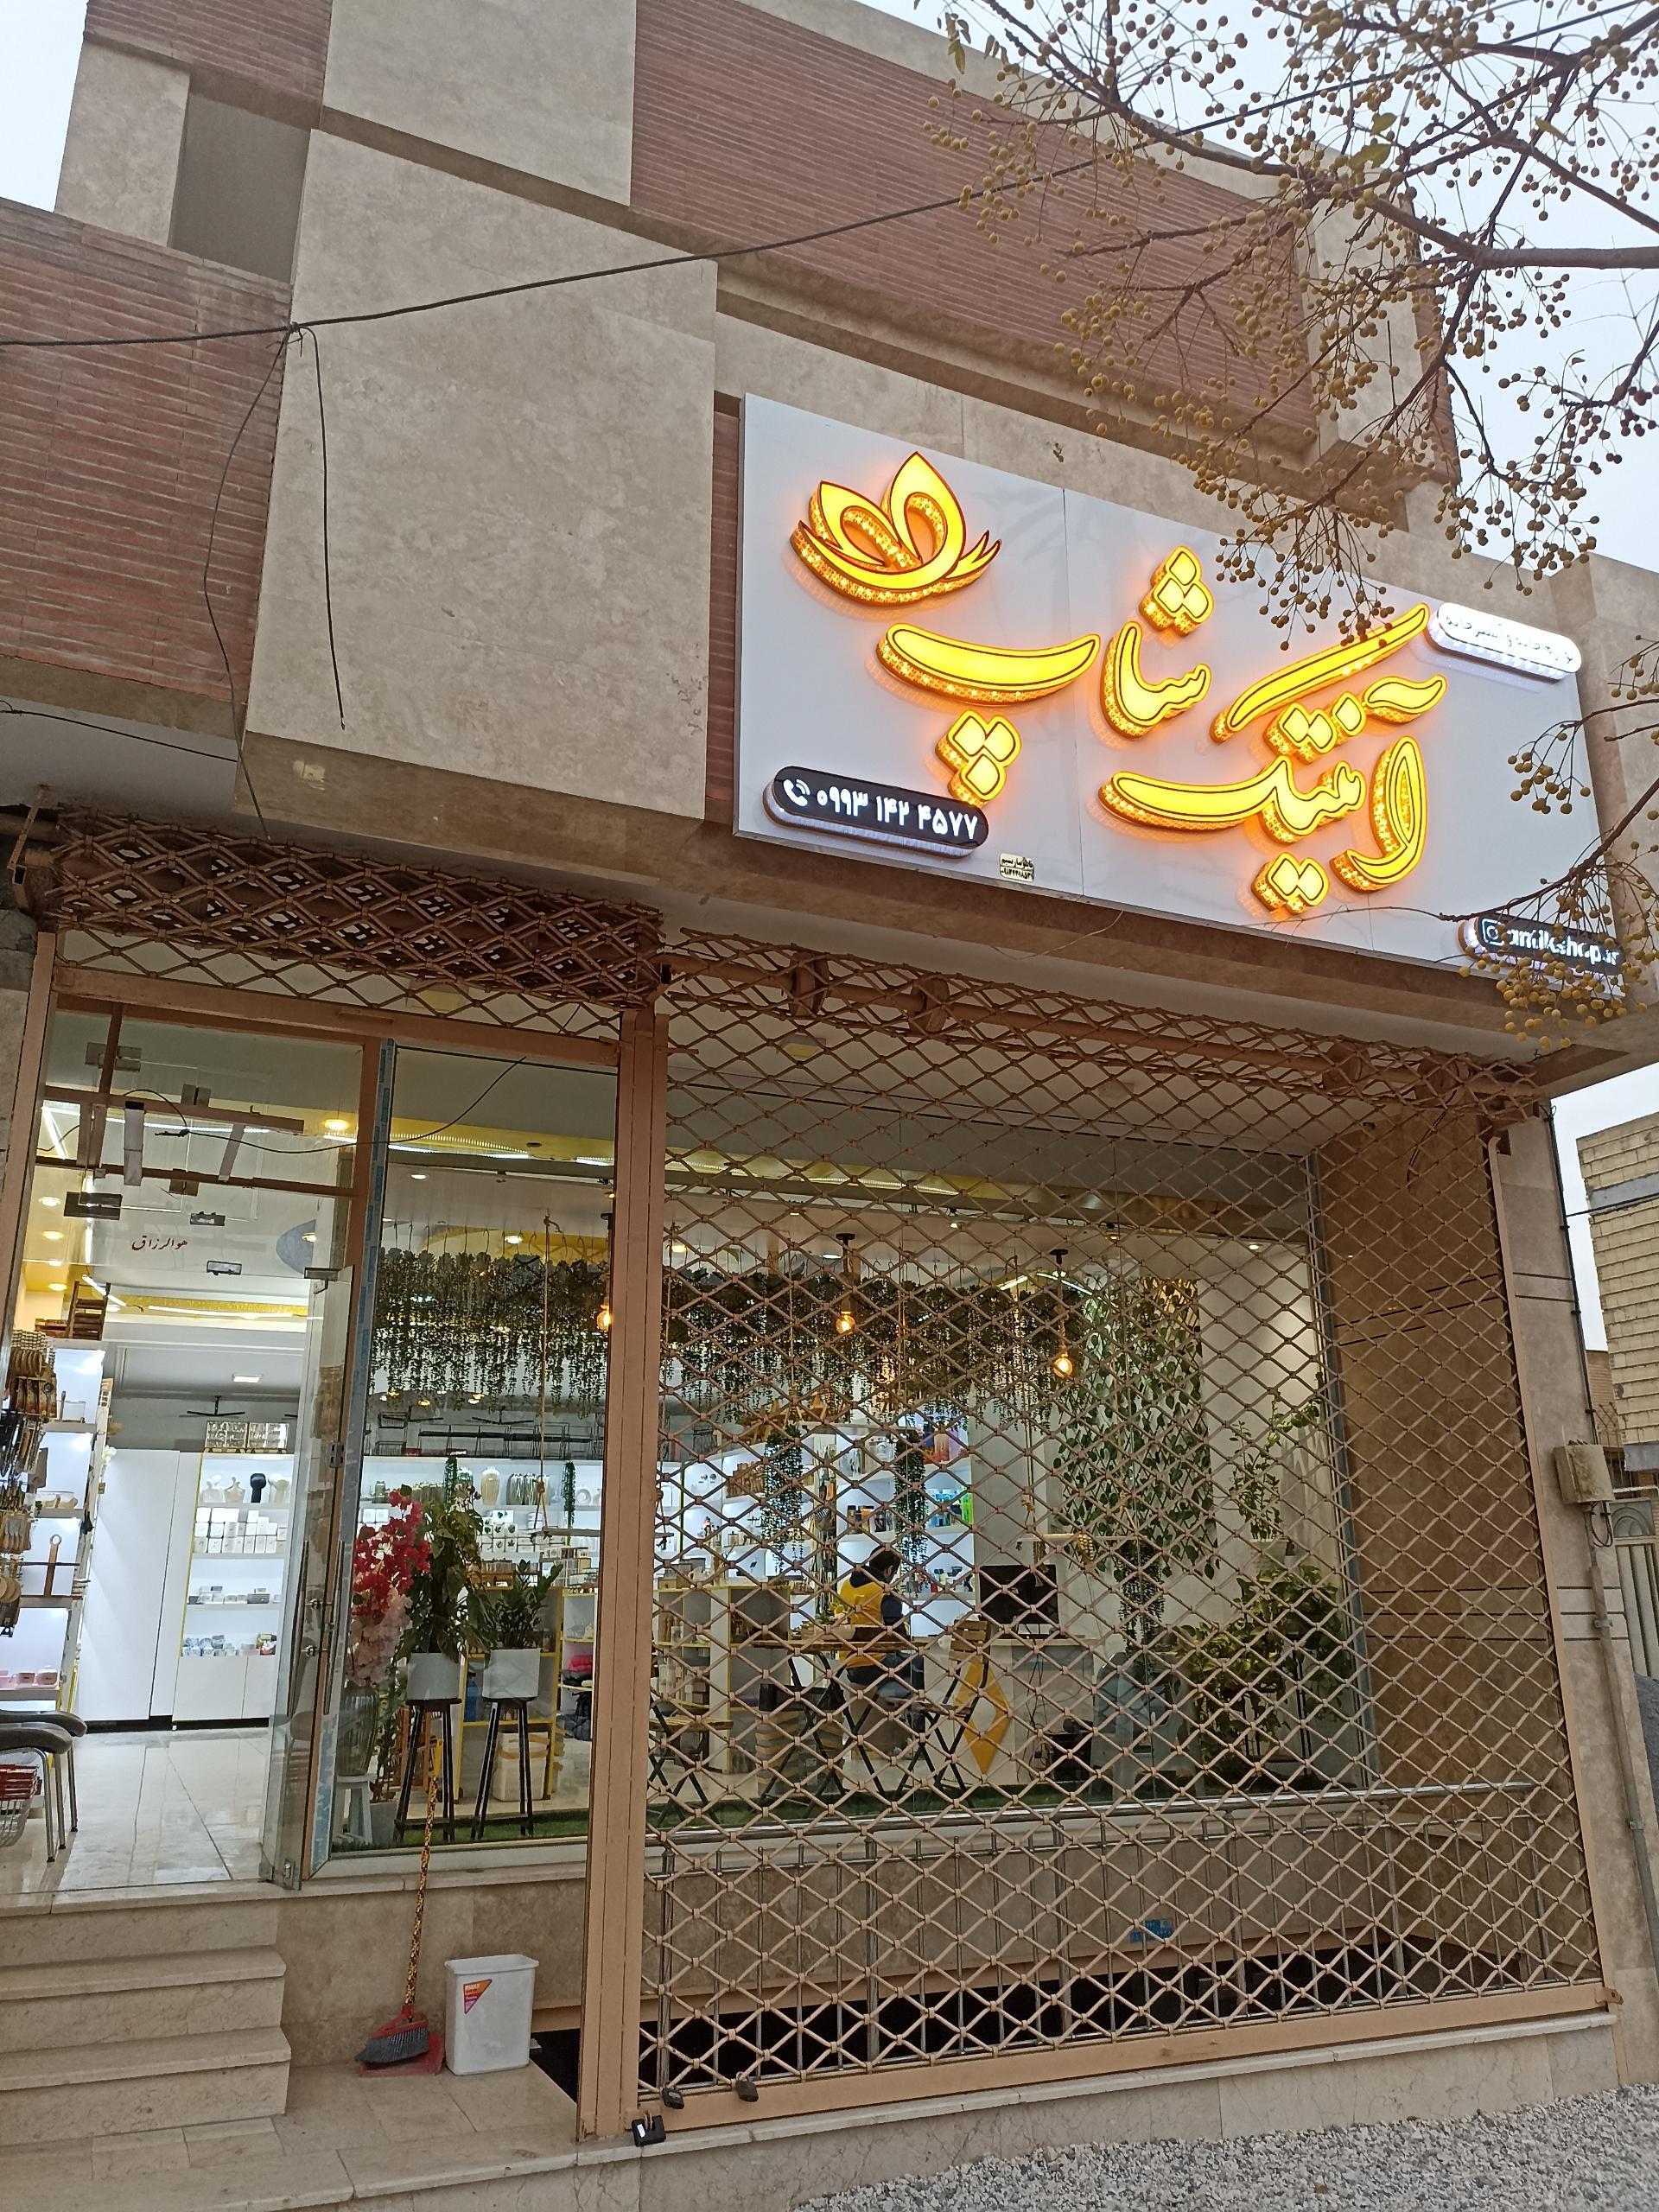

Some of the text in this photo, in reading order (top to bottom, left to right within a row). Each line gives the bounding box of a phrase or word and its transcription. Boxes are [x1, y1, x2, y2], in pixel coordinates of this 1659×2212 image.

[817, 786, 978, 840] ۰۹۹۳ ۱۴۲ ۴۵۷۷
[877, 545, 1446, 914] آنتیک شاپ
